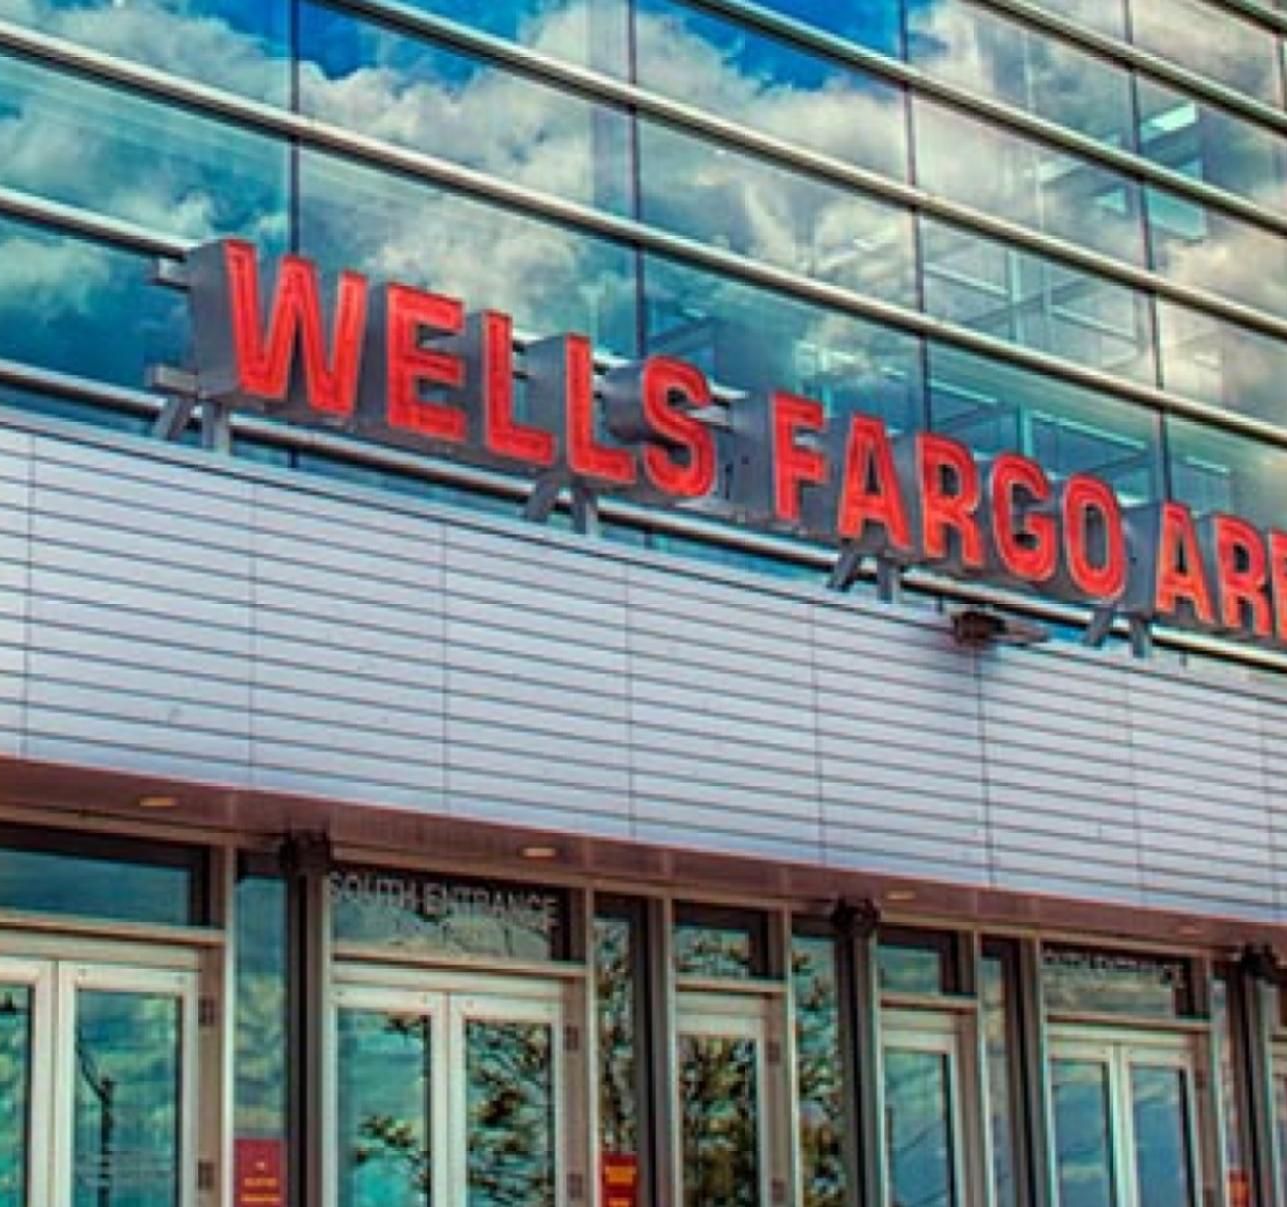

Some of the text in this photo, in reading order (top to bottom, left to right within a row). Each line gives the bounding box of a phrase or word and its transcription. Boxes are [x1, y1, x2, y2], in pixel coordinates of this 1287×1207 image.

[224, 238, 714, 498] WELLS
[770, 391, 1127, 600] FARGO
[328, 870, 561, 932] SOUTH ENTRANCE
